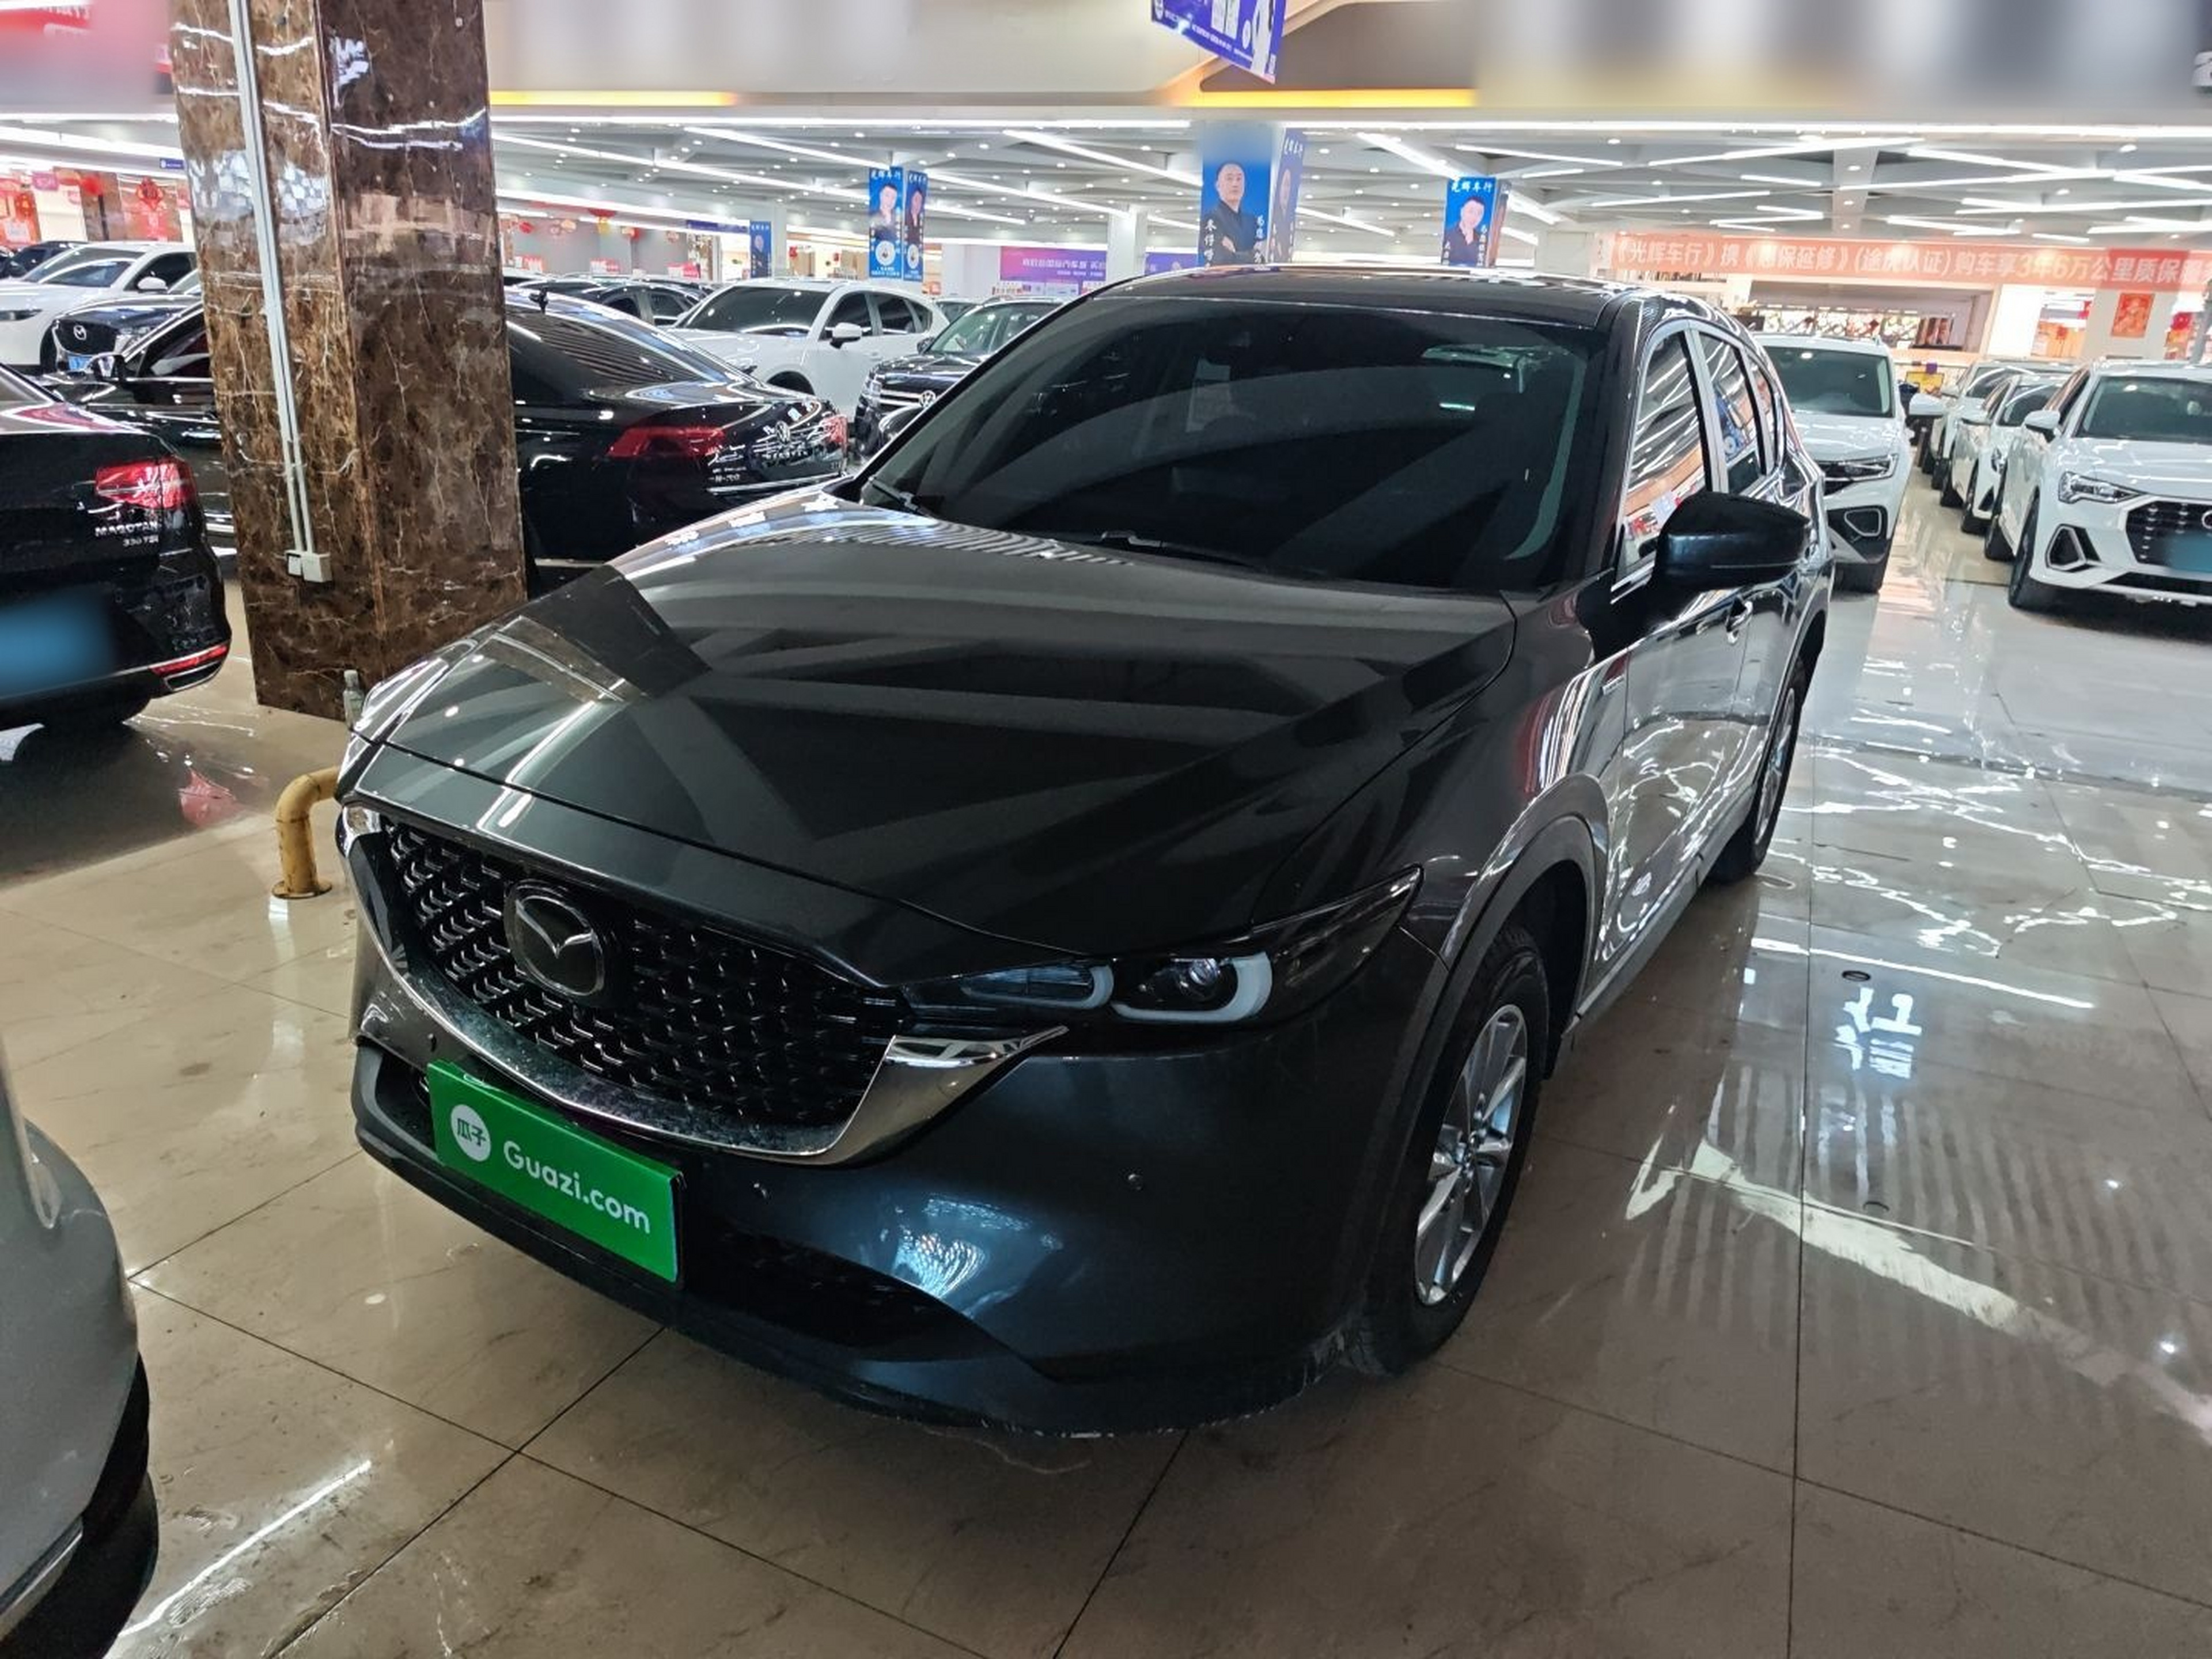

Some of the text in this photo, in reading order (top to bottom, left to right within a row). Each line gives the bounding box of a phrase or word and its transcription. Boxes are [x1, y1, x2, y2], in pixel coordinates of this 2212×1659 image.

[95, 521, 158, 536] MAGOTAN
[456, 1118, 487, 1147] 瓜子
[503, 1140, 651, 1234] Guazi.com
